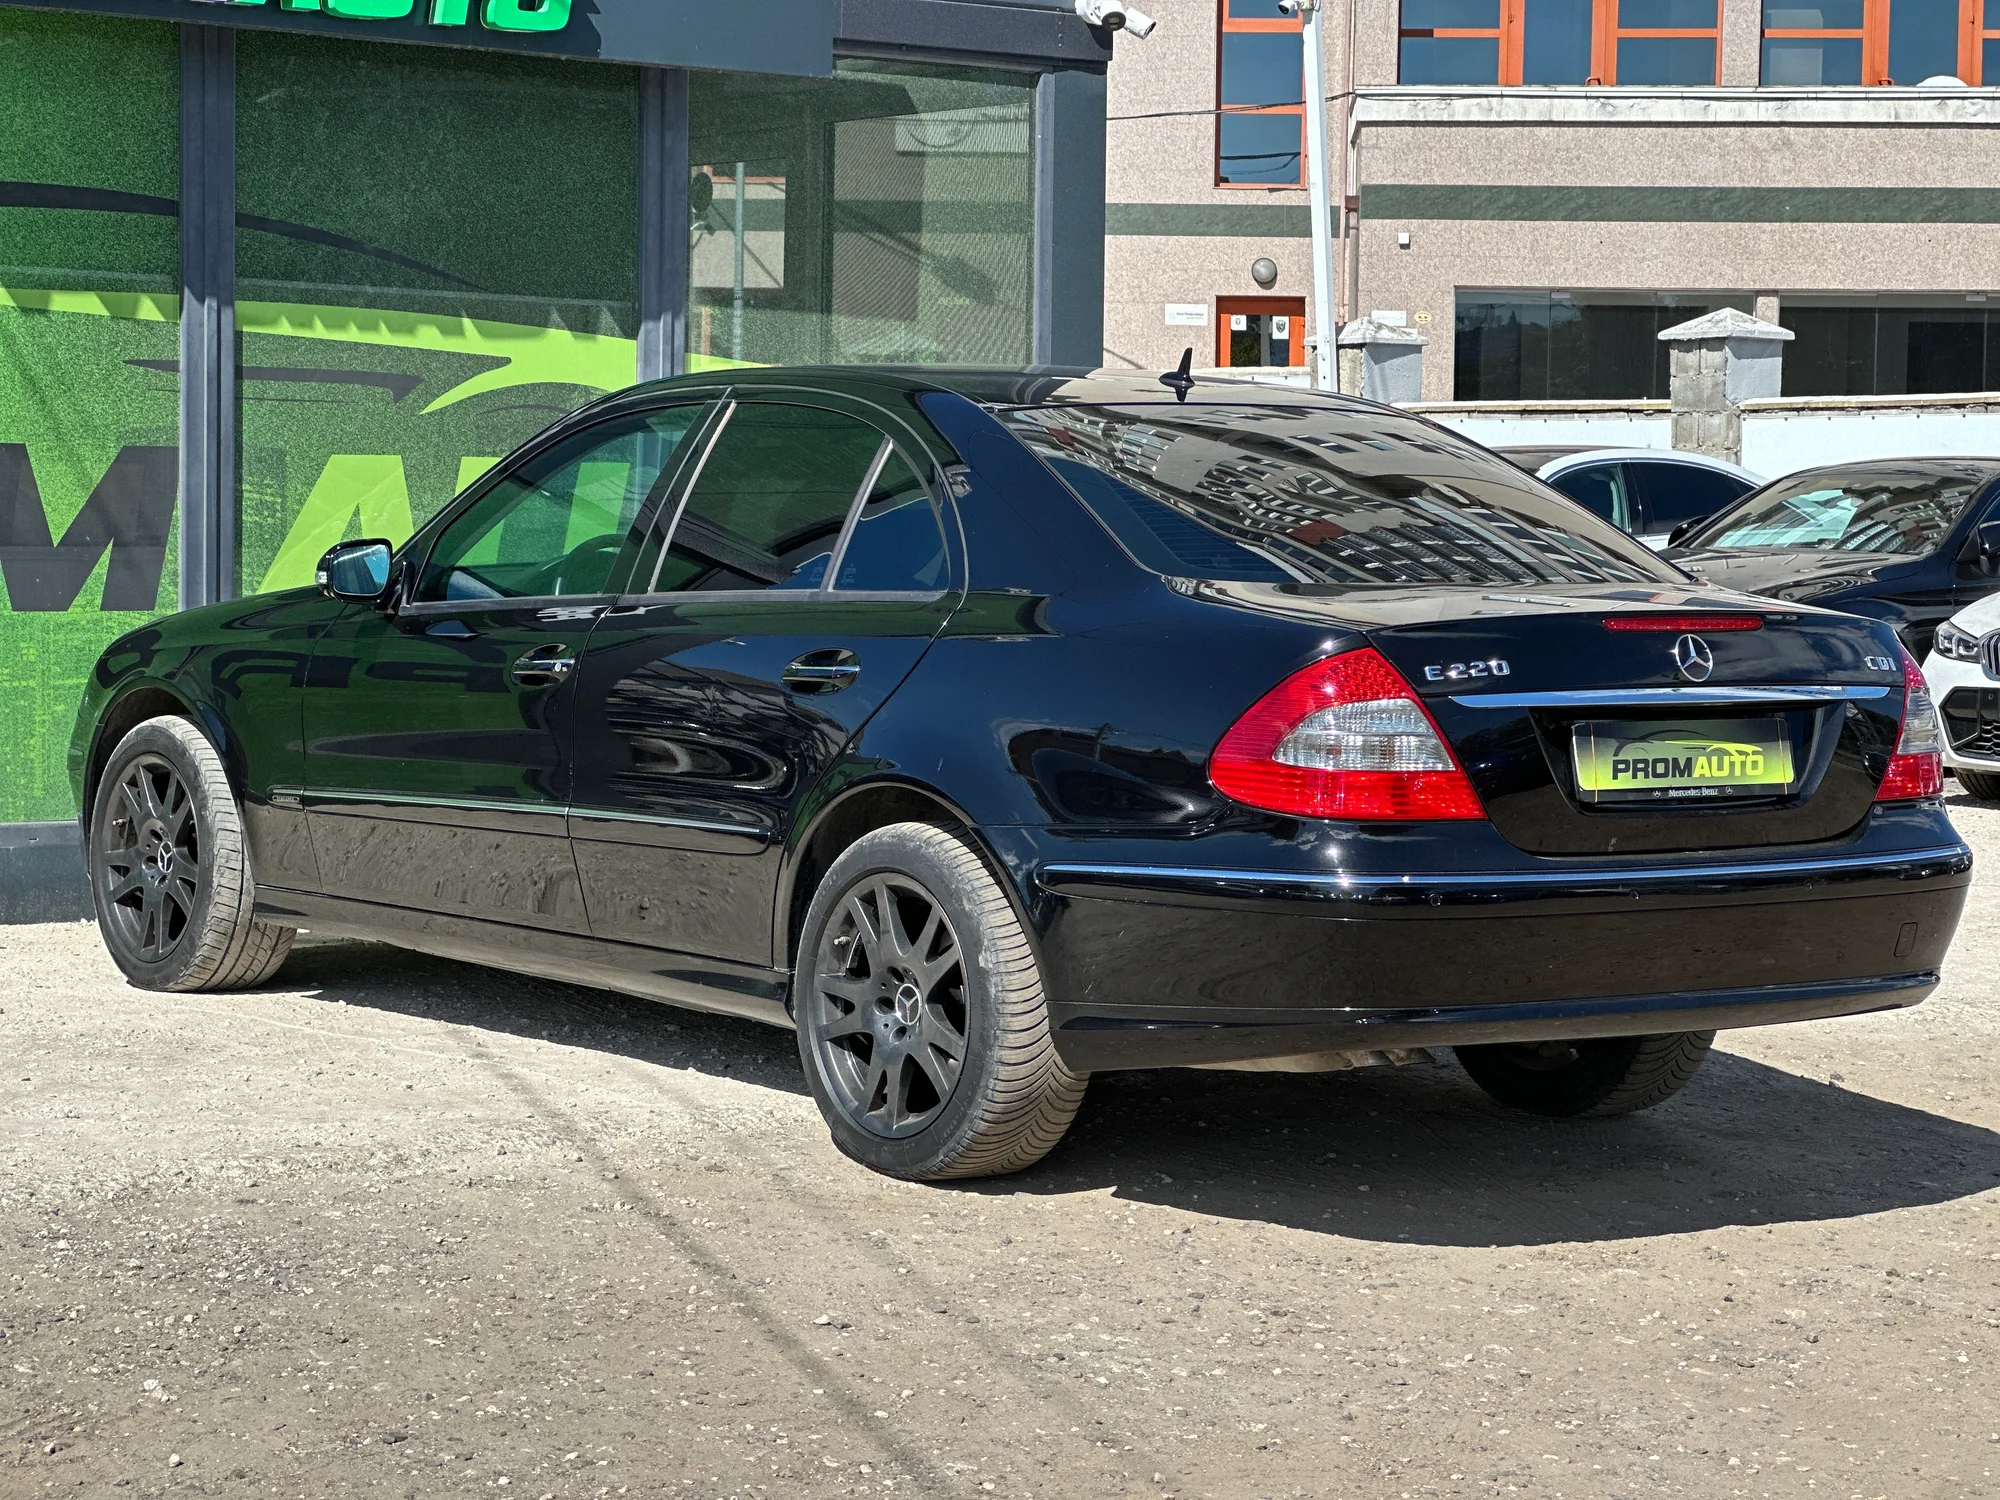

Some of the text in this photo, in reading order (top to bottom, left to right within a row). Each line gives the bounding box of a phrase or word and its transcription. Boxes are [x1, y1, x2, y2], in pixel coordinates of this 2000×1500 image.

[1864, 656, 1897, 671] CDI
[1612, 754, 1765, 780] PROMAUTO
[1668, 787, 1719, 798] Mercedes-Benz
